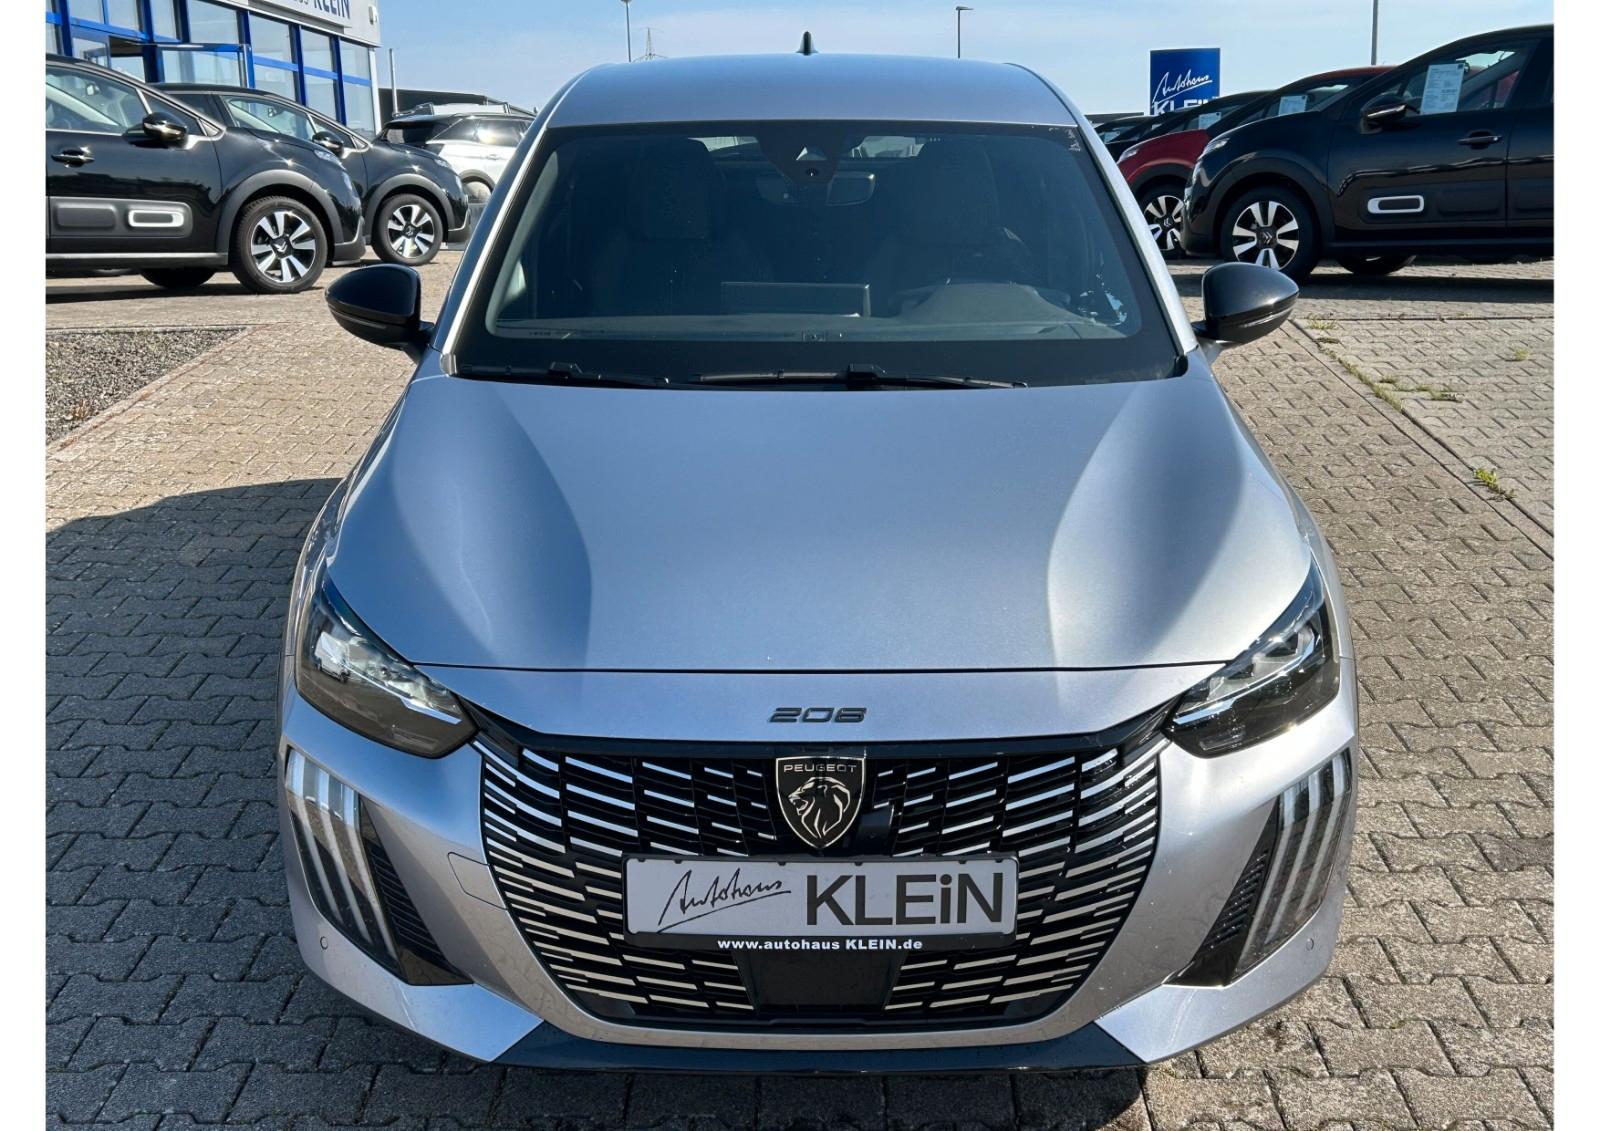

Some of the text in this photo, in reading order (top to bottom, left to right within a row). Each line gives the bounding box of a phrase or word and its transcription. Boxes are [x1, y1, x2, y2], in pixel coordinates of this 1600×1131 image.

[769, 707, 867, 723] 208
[783, 763, 857, 773] PEUGEOT
[657, 867, 787, 928] Autohaus
[717, 938, 923, 951] www.autohaus KLEIN.de
